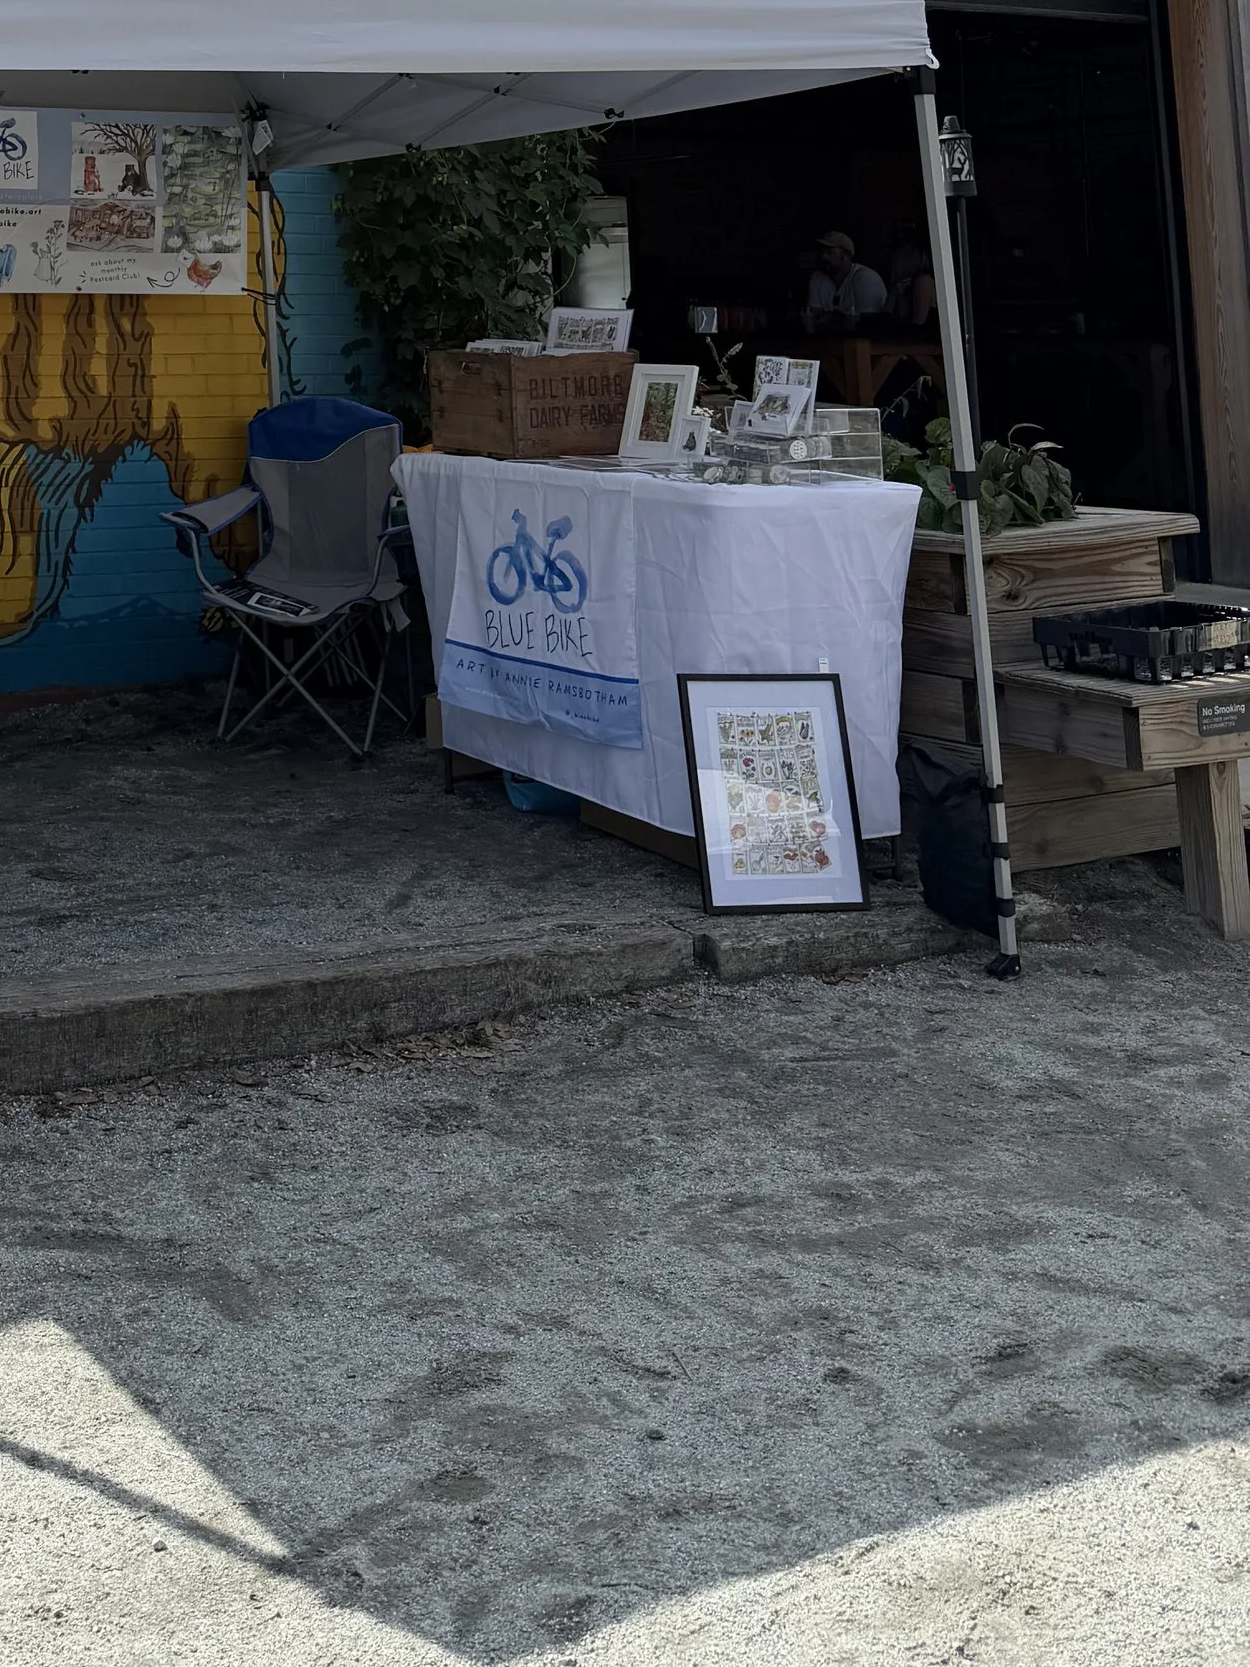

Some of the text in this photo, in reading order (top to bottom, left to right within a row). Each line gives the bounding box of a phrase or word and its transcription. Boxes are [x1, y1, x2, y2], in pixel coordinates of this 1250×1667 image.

[3, 161, 35, 181] BIKE
[90, 258, 137, 268] ask about my
[100, 266, 128, 274] monthly
[89, 272, 141, 283] Postcard Club!
[529, 374, 623, 400] BILTMORE
[529, 405, 571, 429] DAIRY
[485, 609, 593, 658] BLUE BIKE
[456, 658, 486, 673] ART
[505, 671, 541, 689] ANNIE
[548, 679, 628, 707] RAMSBOTHAM
[1202, 703, 1246, 717] No Smoking
